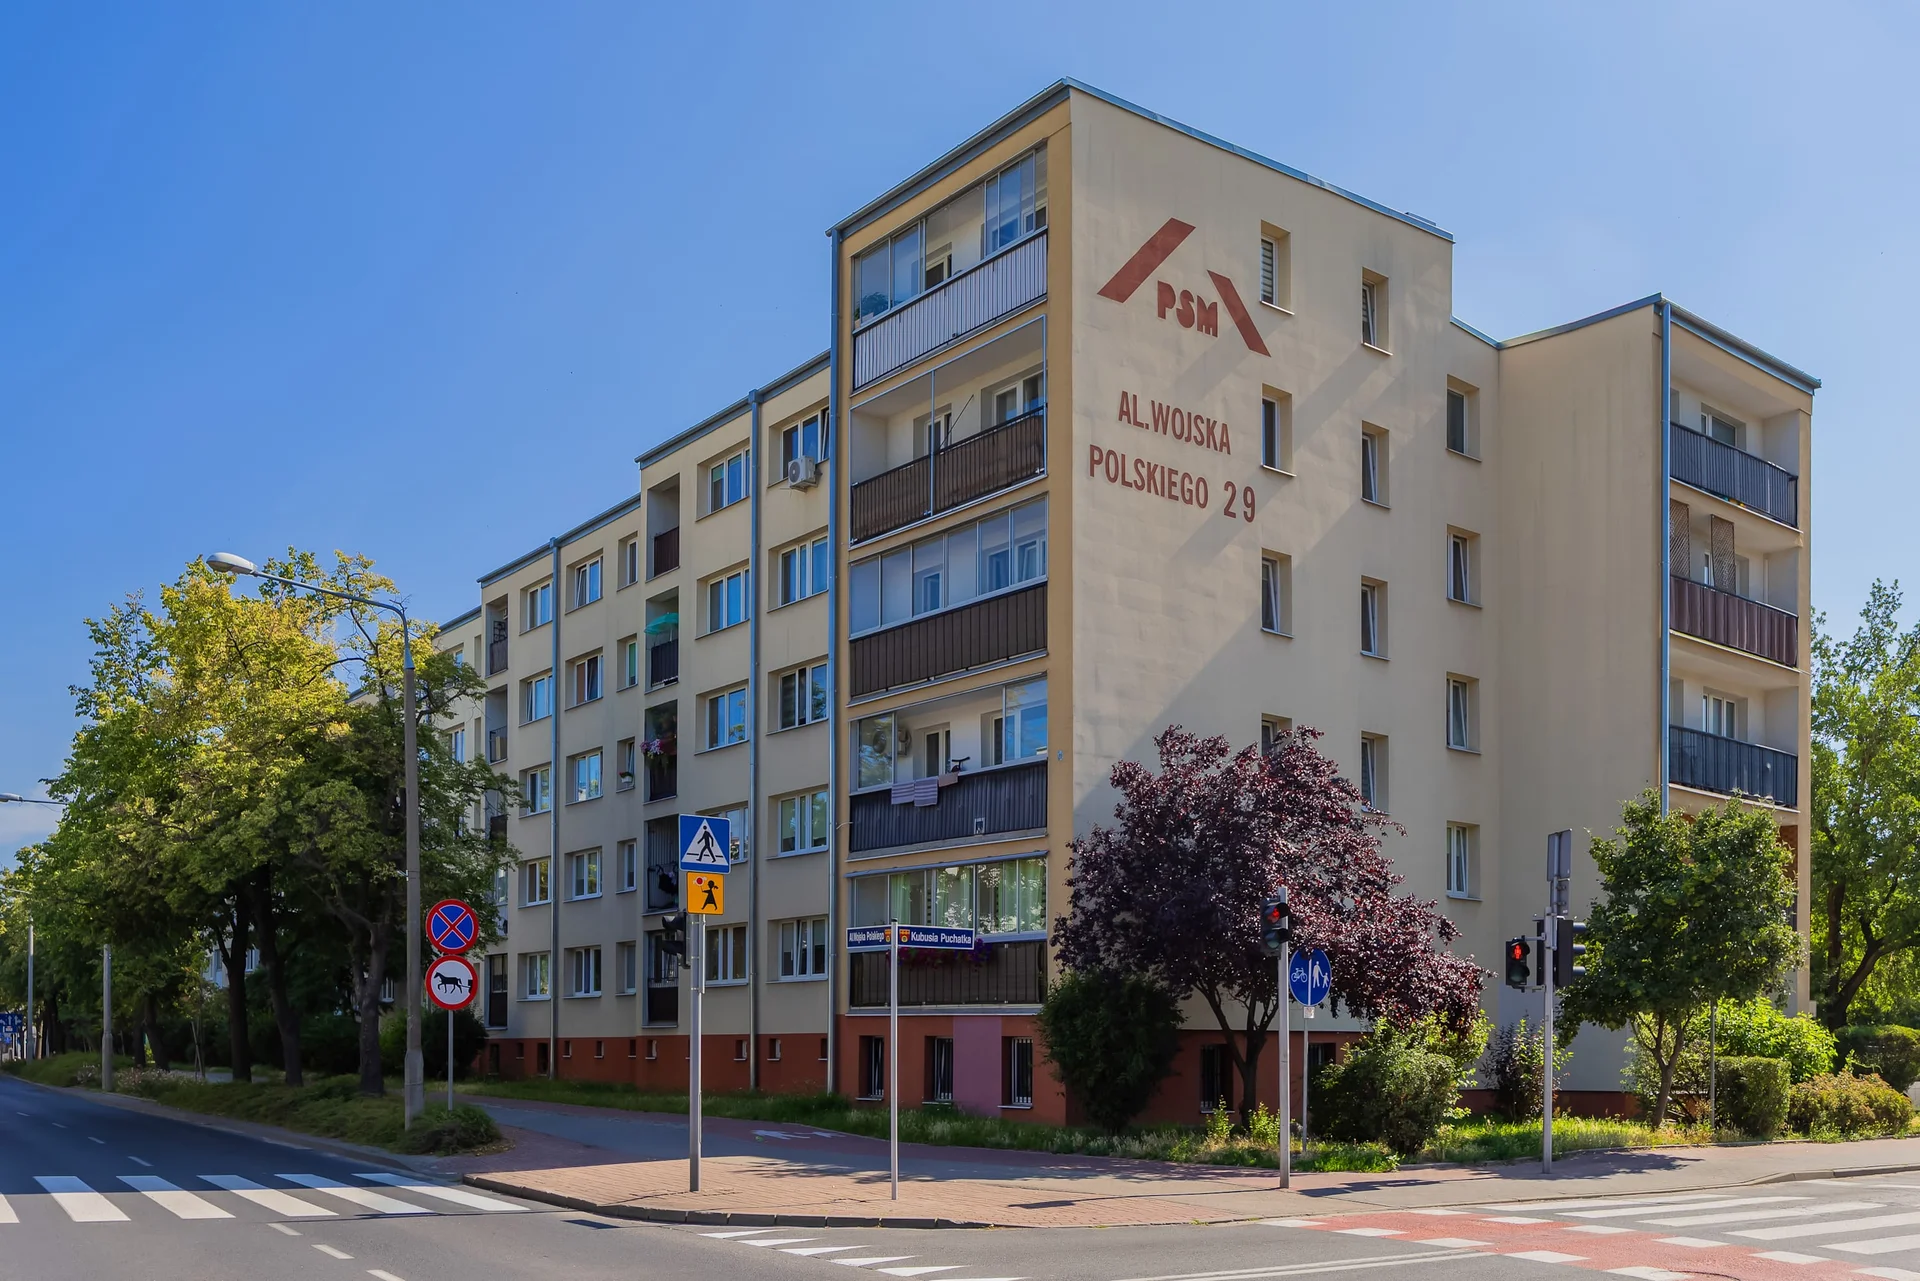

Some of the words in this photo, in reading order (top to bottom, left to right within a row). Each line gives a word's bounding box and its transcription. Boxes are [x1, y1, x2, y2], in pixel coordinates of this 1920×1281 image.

[1157, 280, 1218, 337] PSM
[1118, 390, 1231, 455] AL.WOJSKA
[1089, 444, 1208, 509] POLSKIEGO
[911, 931, 938, 943] Kubusia
[940, 933, 971, 944] Puchatka
